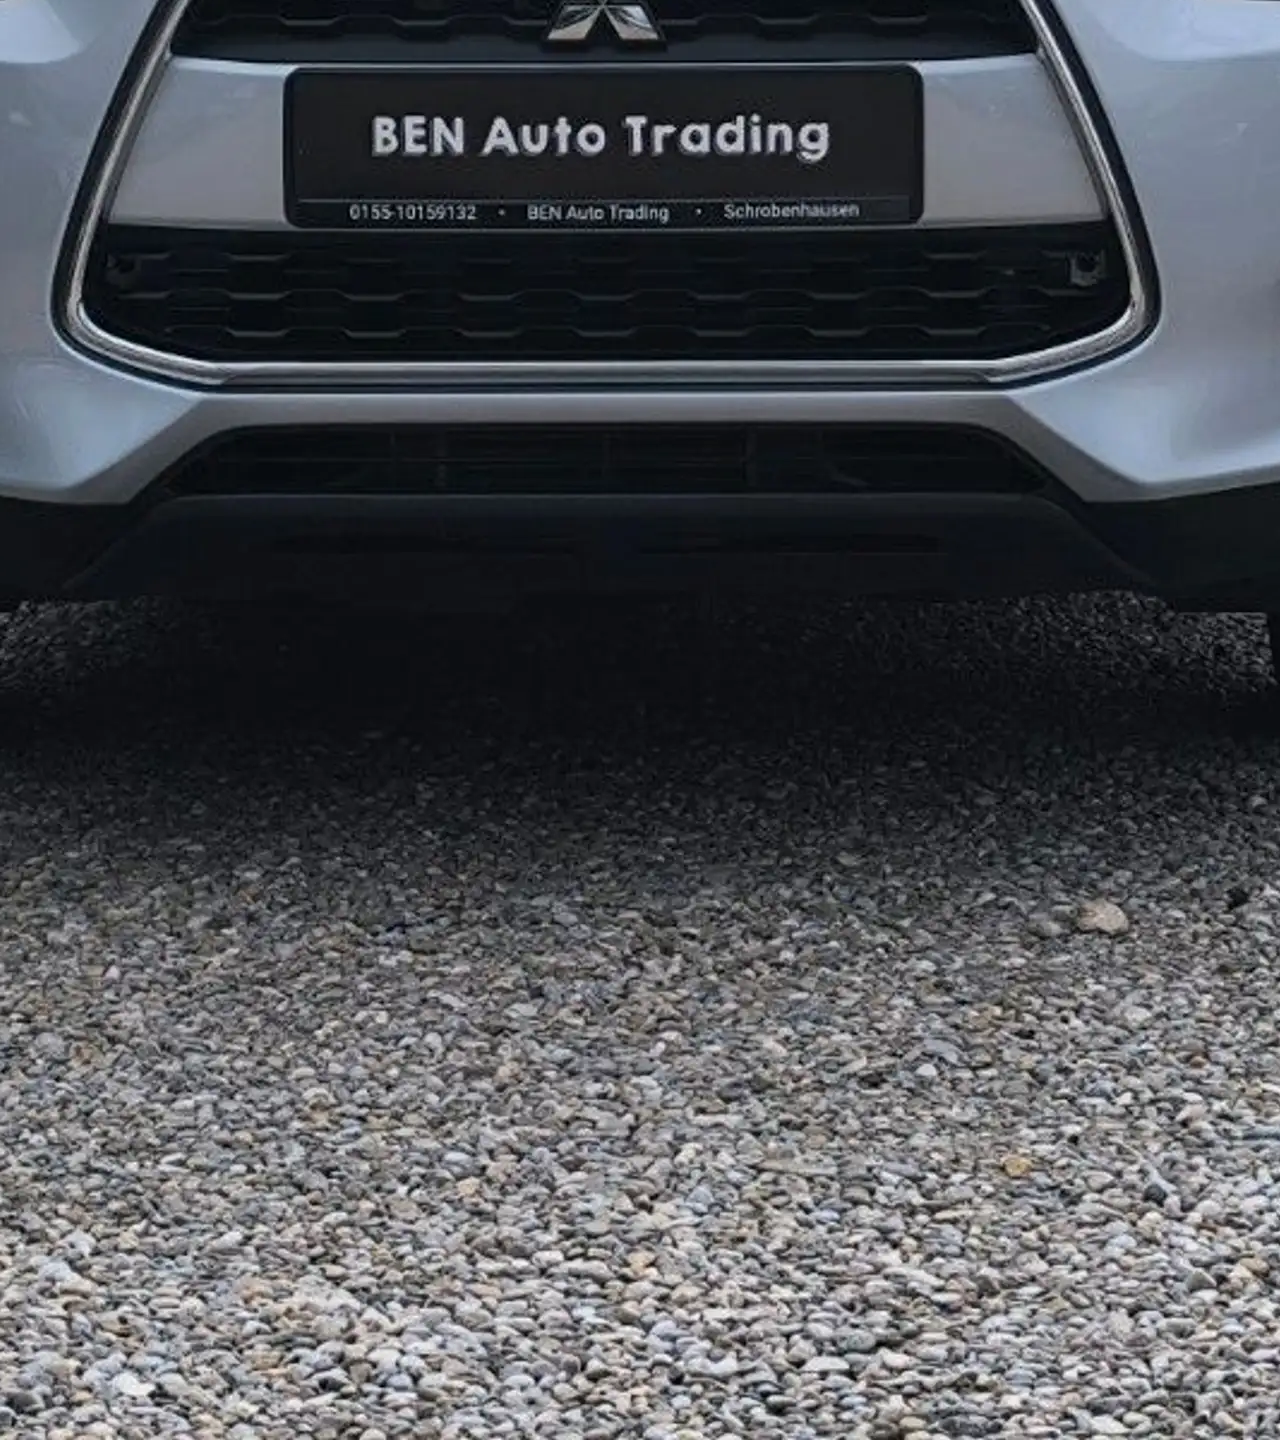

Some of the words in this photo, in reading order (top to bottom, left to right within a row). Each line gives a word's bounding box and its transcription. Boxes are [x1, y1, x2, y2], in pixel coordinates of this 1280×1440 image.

[371, 115, 465, 155] BEN
[482, 115, 606, 155] Auto
[624, 113, 831, 163] Trading
[349, 203, 478, 221] 0155-10159132
[527, 204, 562, 221] BEN
[566, 205, 605, 221] Auto
[610, 204, 669, 224] Trading
[723, 201, 860, 220] Schrobenhausen
